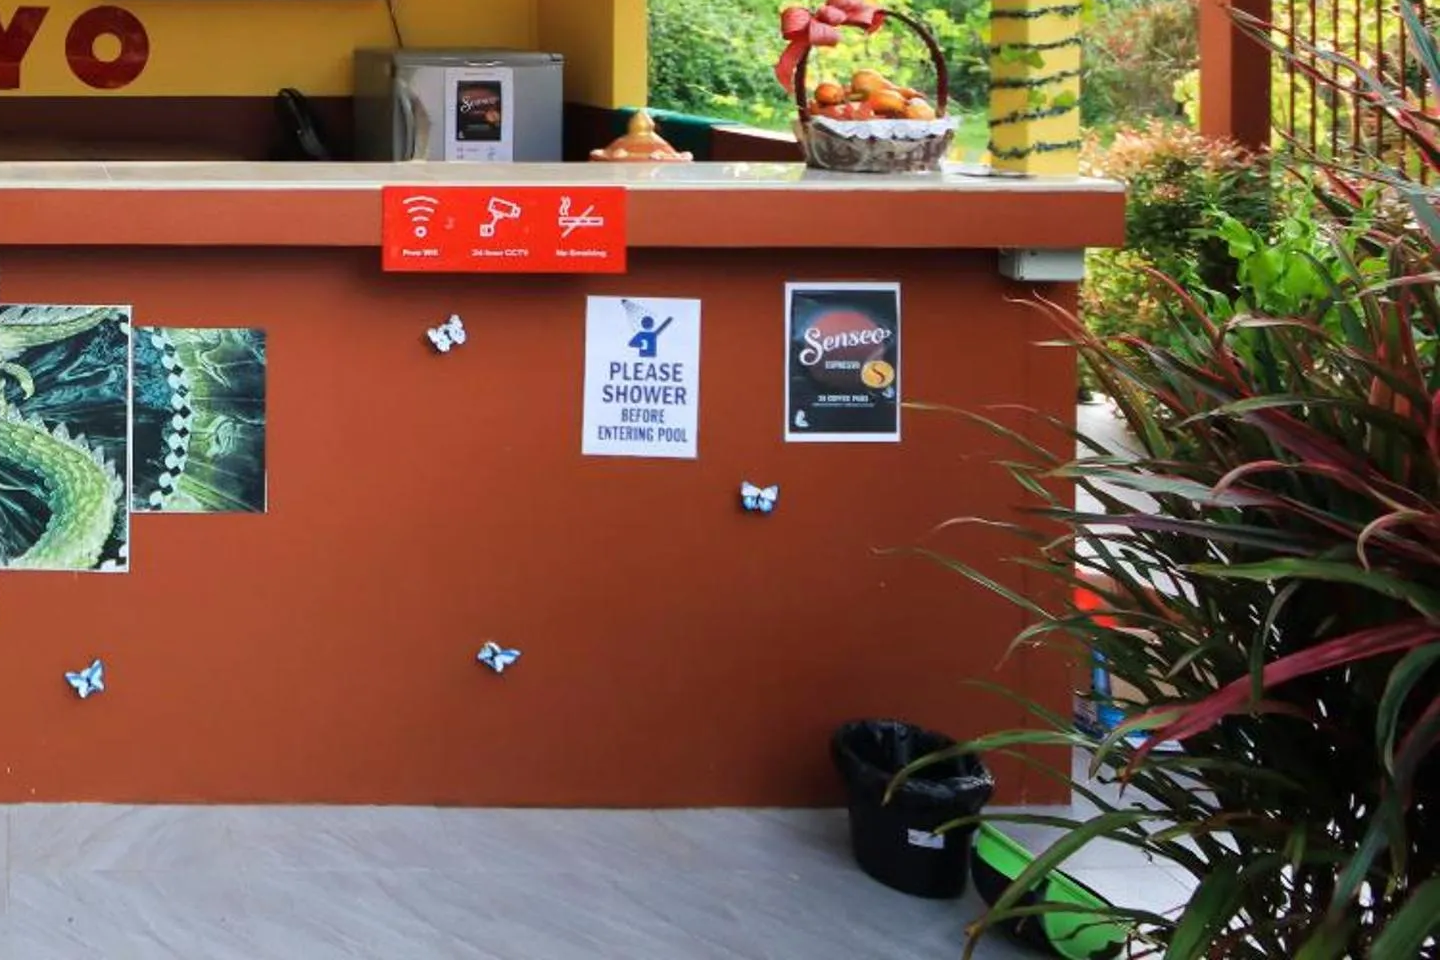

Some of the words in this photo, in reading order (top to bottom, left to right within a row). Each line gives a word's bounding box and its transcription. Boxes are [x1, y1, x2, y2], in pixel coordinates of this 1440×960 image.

[504, 248, 529, 257] CCTV
[799, 327, 892, 366] Senseo
[610, 361, 683, 383] PLEASE
[602, 384, 687, 405] SHOWER
[621, 407, 665, 424] BEFORE
[598, 425, 654, 442] ENTERING
[658, 427, 688, 443] POOL
